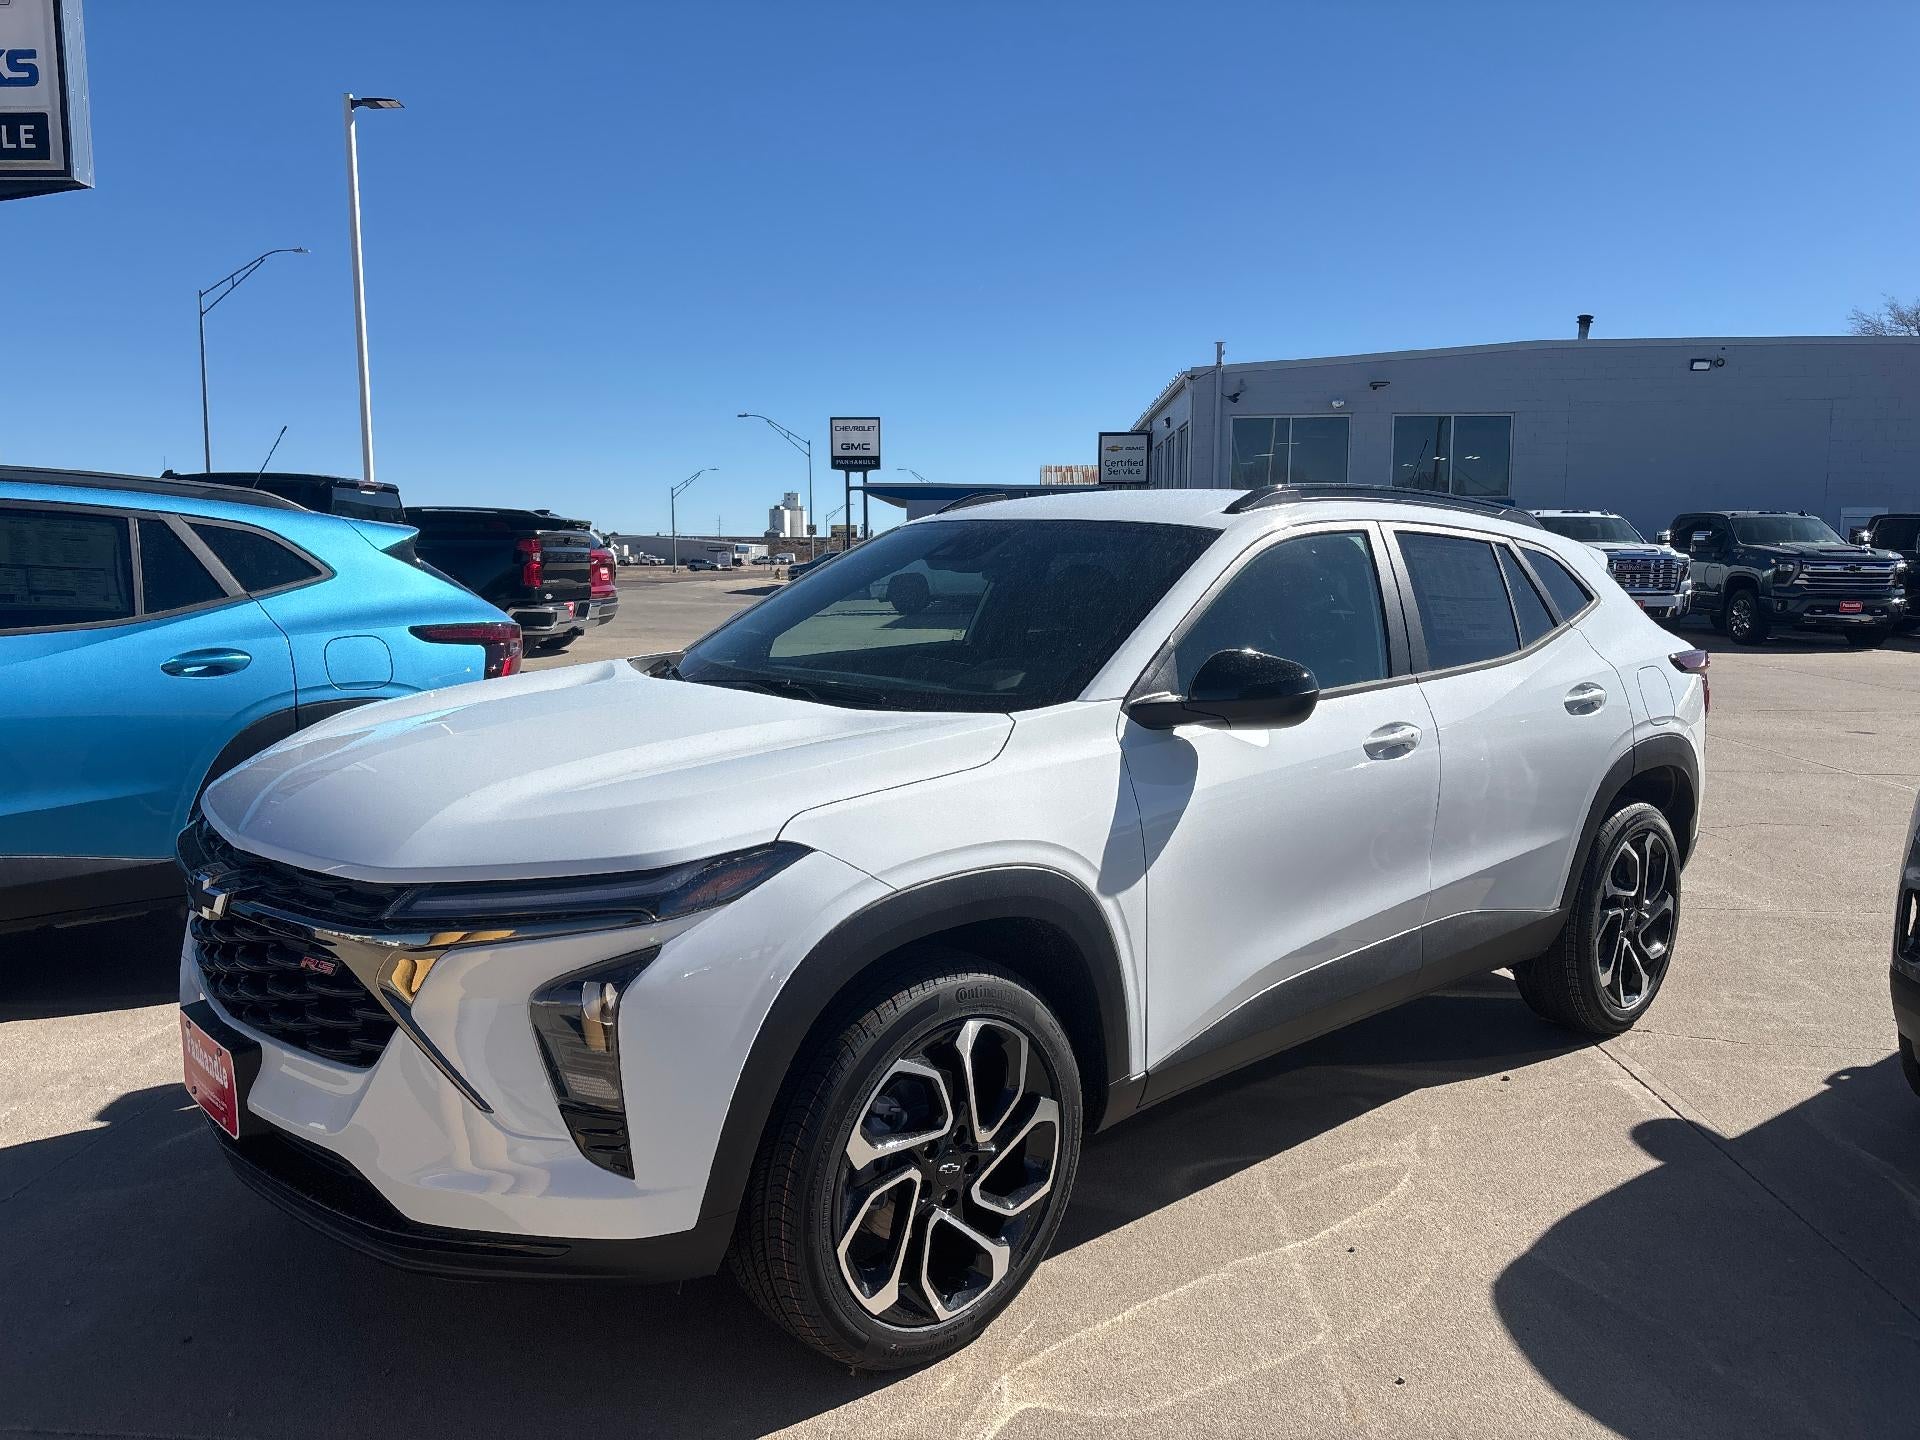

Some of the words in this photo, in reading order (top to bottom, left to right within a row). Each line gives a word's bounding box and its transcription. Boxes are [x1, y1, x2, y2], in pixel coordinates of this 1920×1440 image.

[1, 124, 37, 149] LE
[840, 443, 871, 451] GMC
[1104, 459, 1144, 468] Certified
[1107, 467, 1141, 476] Service
[300, 956, 336, 976] RS
